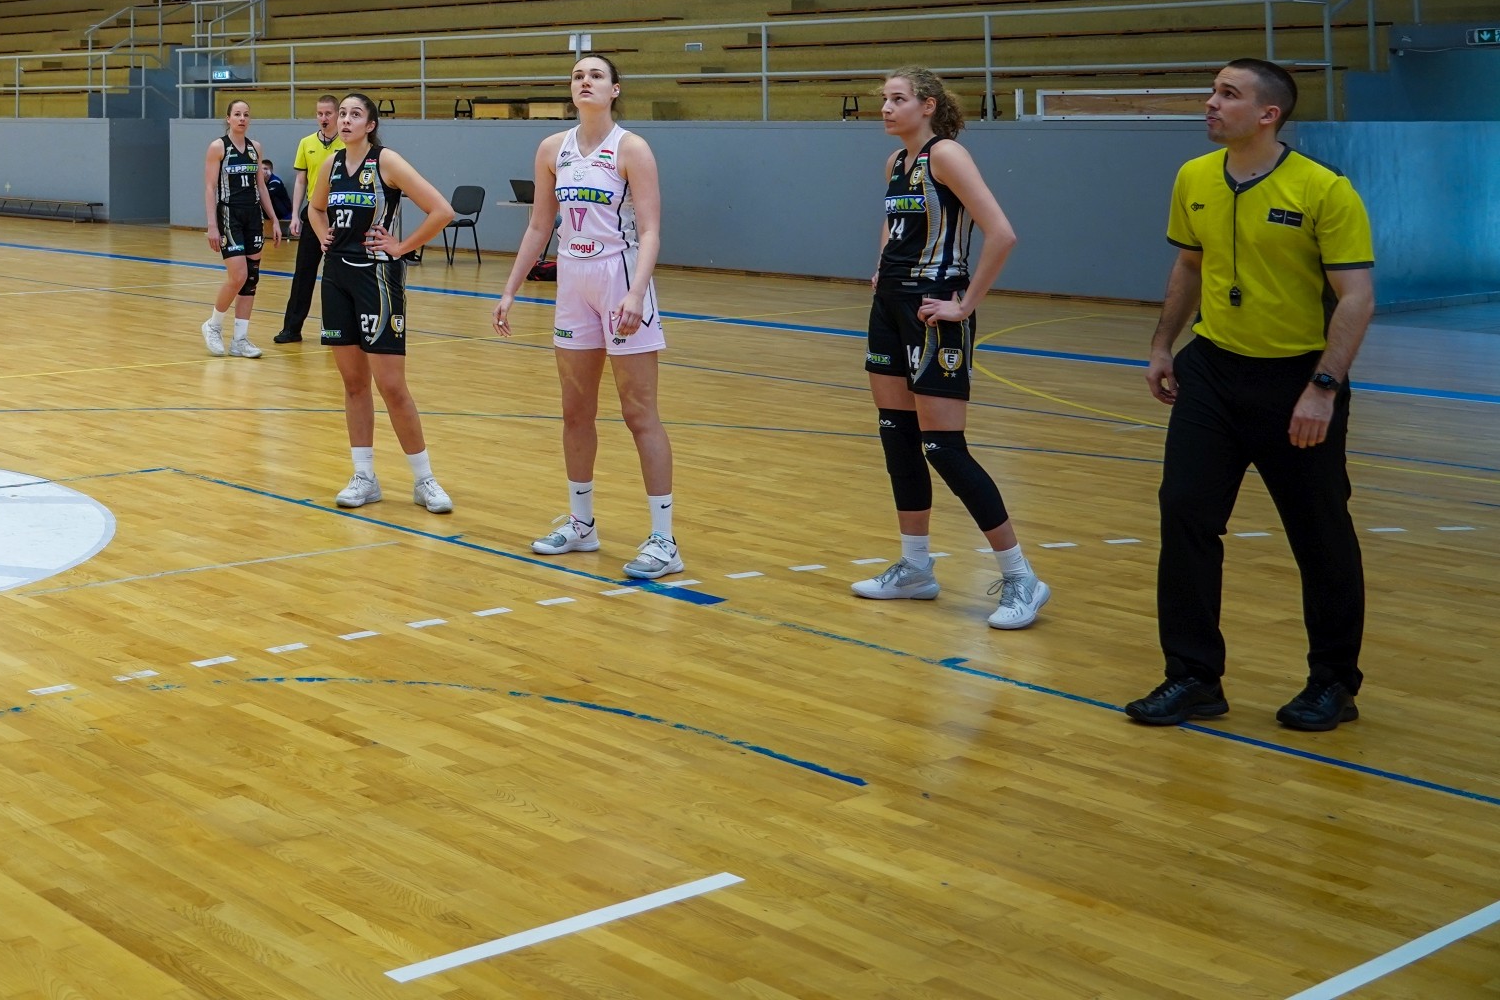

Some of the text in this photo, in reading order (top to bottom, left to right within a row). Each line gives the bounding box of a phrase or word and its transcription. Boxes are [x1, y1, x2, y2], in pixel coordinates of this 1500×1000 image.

[241, 175, 250, 187] 11
[336, 209, 353, 228] 27
[569, 208, 587, 231] 17
[889, 218, 905, 240] 14
[570, 242, 595, 253] mogyi
[361, 314, 379, 333] 27
[906, 345, 920, 369] 14
